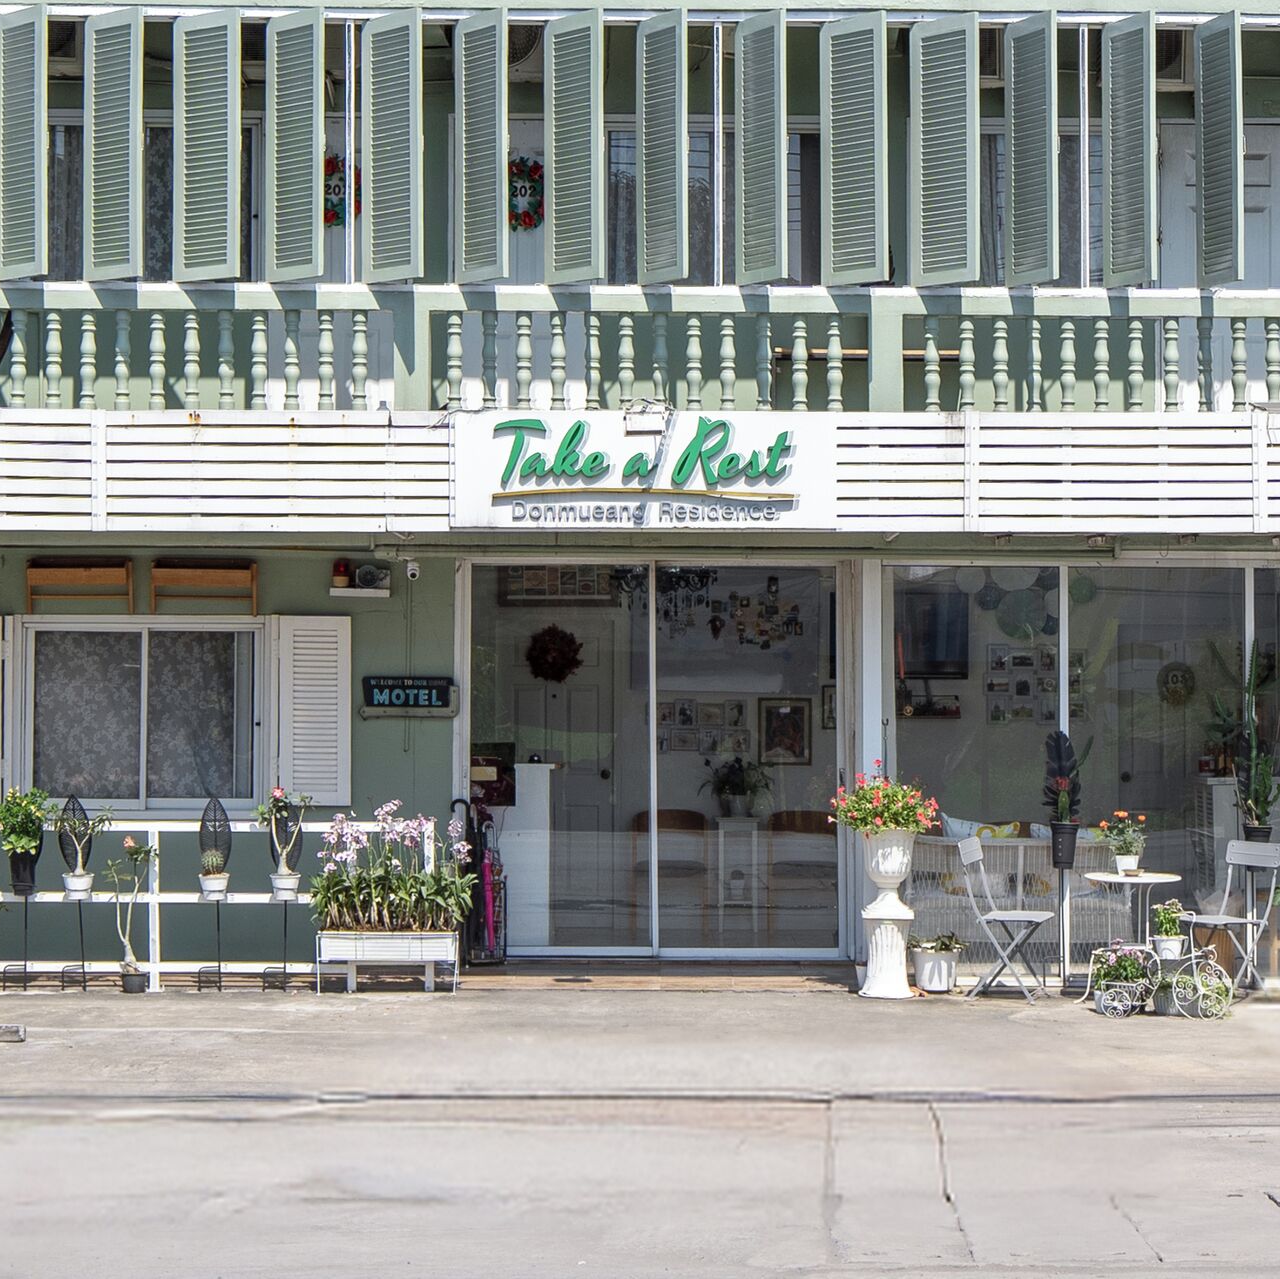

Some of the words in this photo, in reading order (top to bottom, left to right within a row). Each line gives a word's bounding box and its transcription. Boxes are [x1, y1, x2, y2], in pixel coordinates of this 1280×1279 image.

[325, 183, 345, 196] 20
[493, 418, 610, 489] Take
[622, 450, 657, 479] a
[671, 415, 792, 485] Rest
[511, 499, 647, 526] Donmueang
[659, 500, 778, 523] Residence
[373, 688, 442, 705] MOTEL
